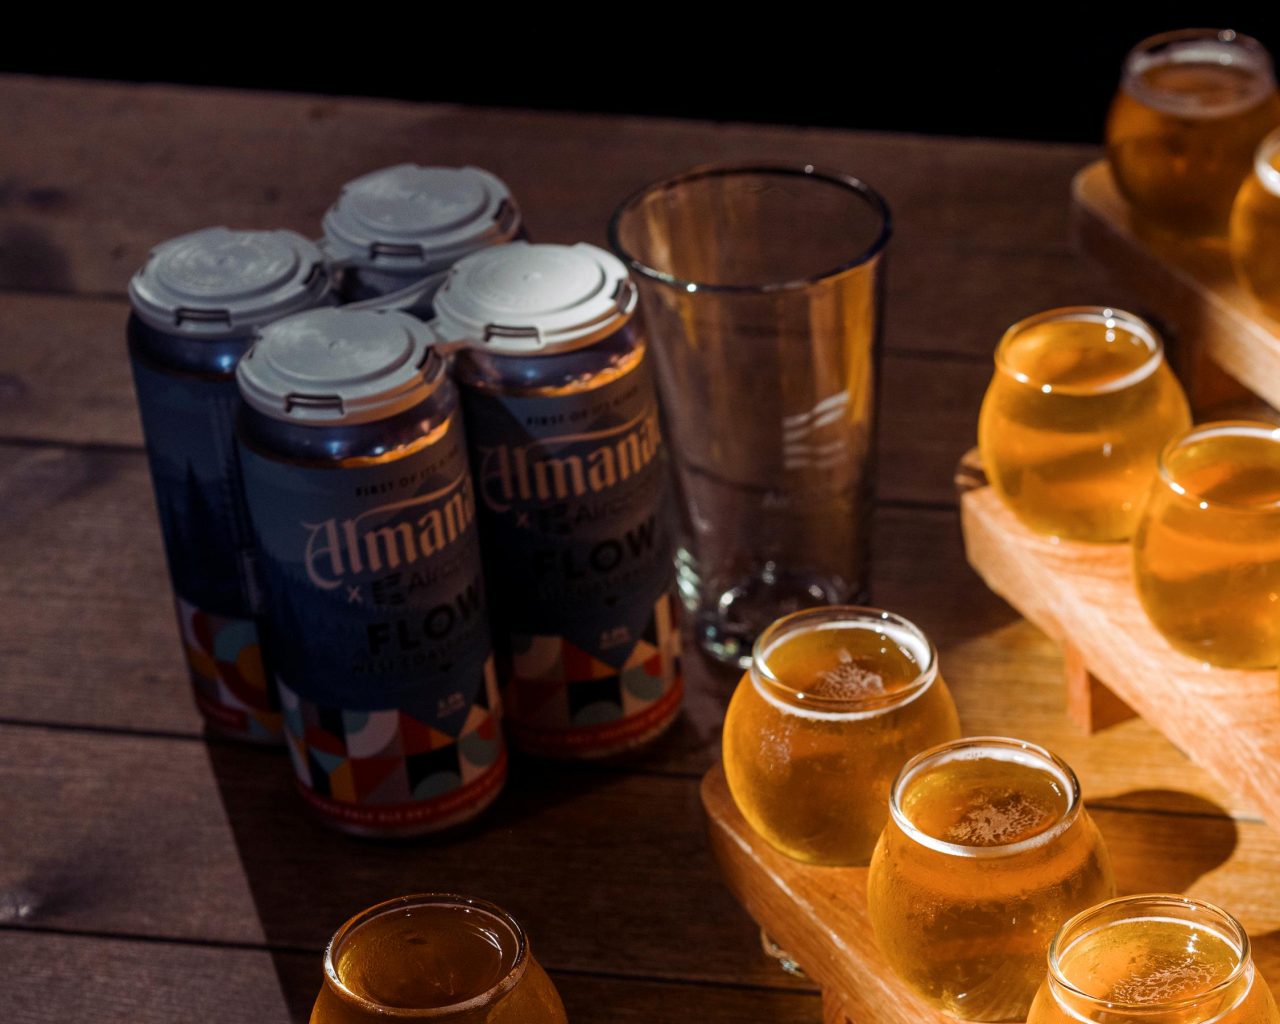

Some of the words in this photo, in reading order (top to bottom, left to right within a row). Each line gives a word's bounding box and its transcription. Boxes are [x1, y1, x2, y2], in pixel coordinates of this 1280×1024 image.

[355, 480, 393, 498] FIRST
[536, 515, 656, 579] FLOW
[368, 577, 481, 654] FLOW
